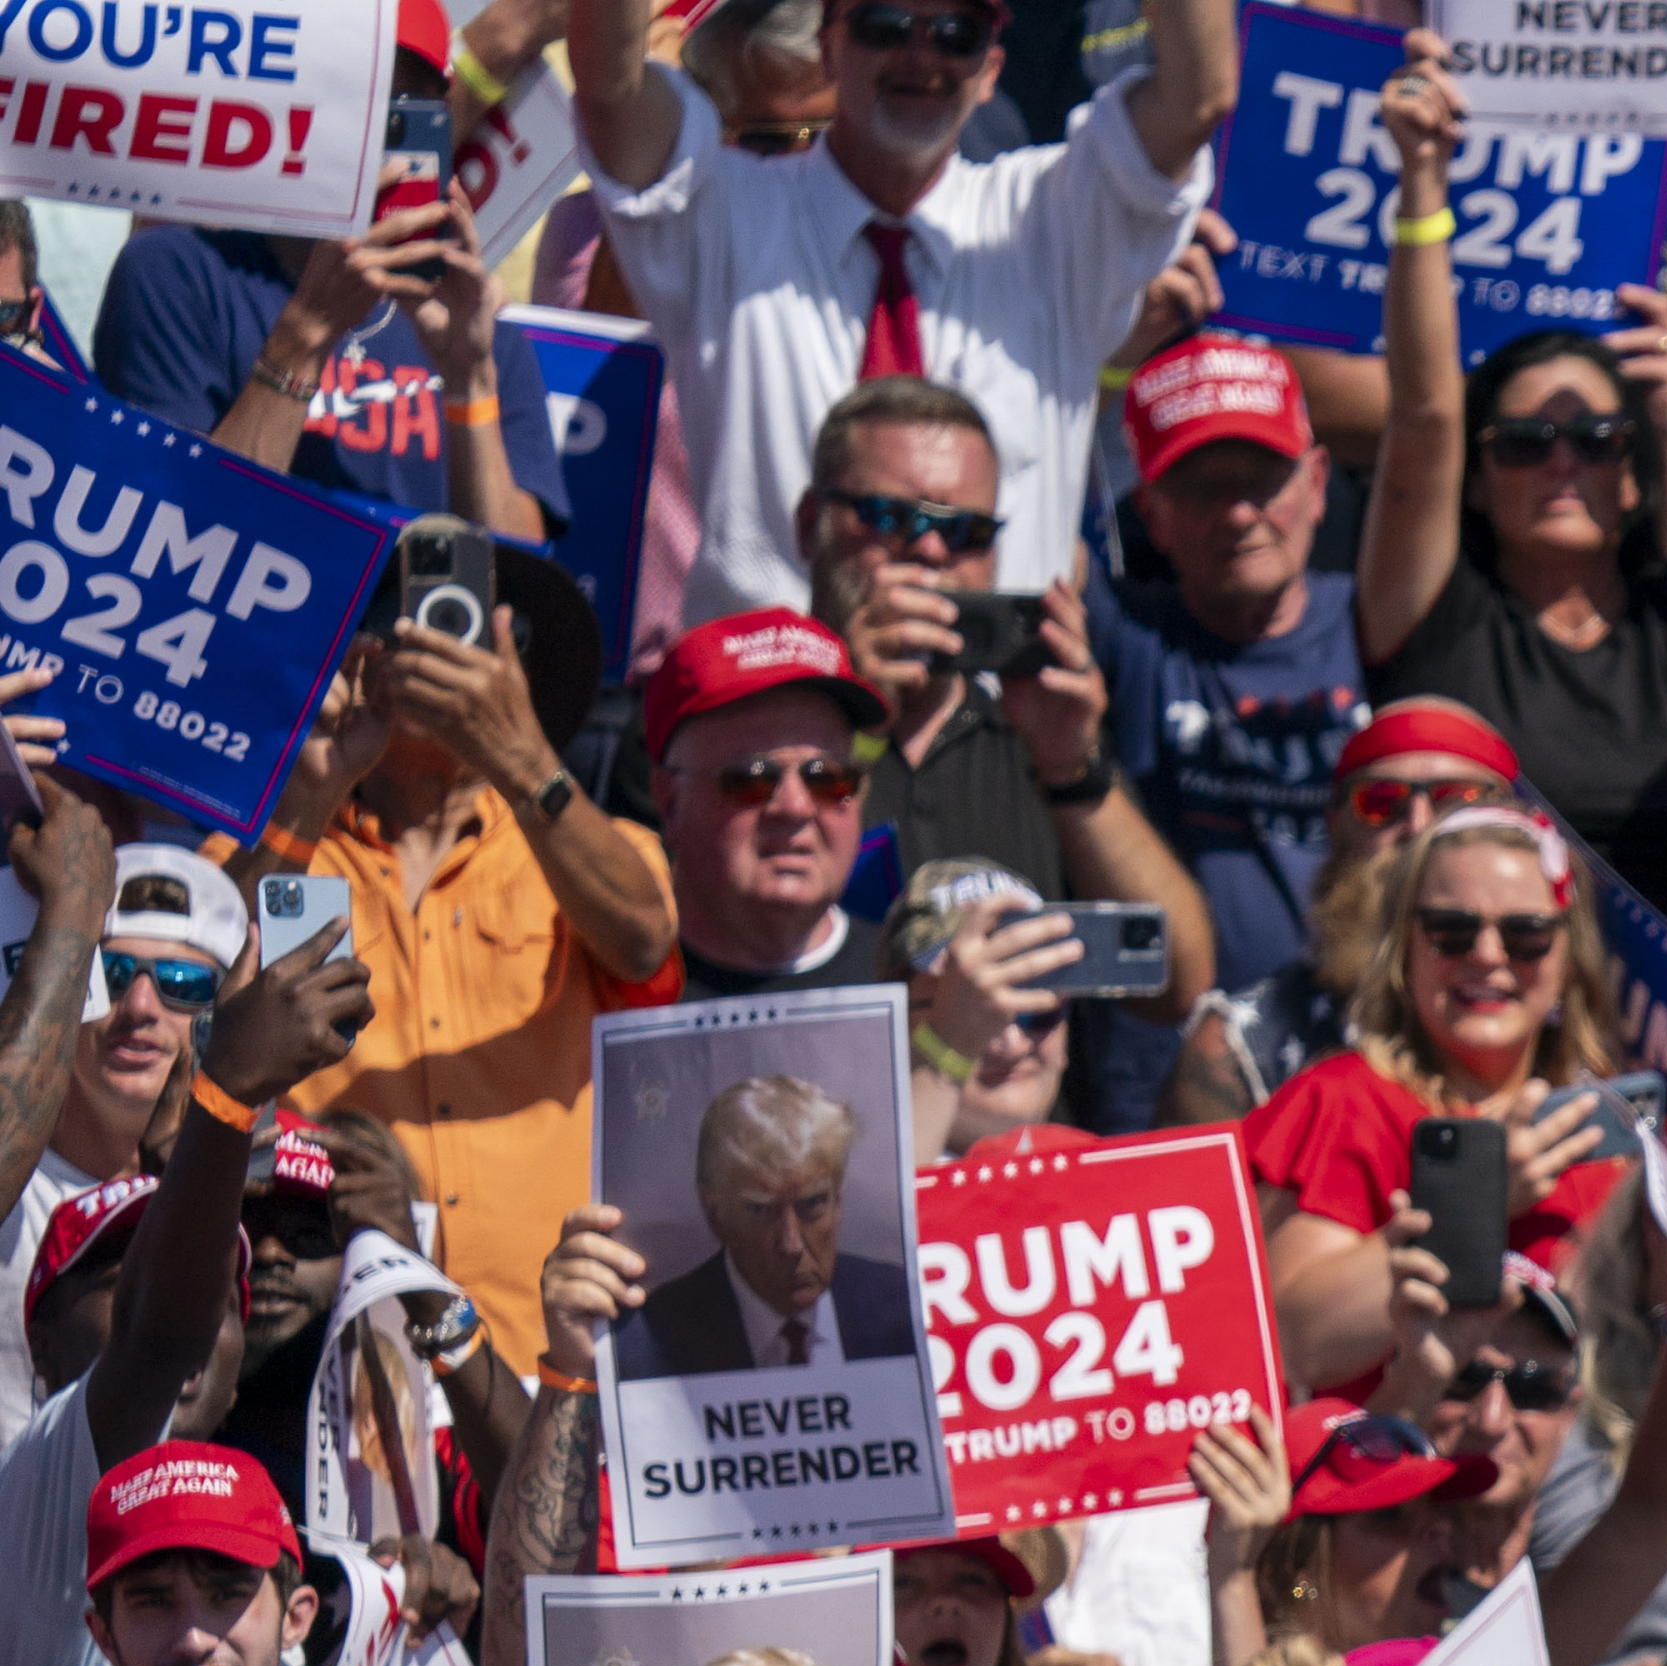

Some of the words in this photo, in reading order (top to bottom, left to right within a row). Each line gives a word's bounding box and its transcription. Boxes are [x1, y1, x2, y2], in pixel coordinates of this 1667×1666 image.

[0, 0, 300, 82] OU'RE
[0, 77, 314, 177] IRED!
[1304, 166, 1584, 276] 224
[1525, 284, 1630, 321] 8802
[0, 424, 313, 622] RUMP
[0, 540, 218, 690] 024
[77, 663, 124, 704] TO
[133, 691, 251, 762] 88022
[917, 1205, 1215, 1330] RUMP
[703, 1394, 852, 1443] NEVER
[943, 1416, 1078, 1465] TRUMP
[1085, 1407, 1135, 1443] TO
[1143, 1387, 1252, 1434] 88022
[117, 1480, 172, 1516] GREAT
[173, 1477, 234, 1498] AGAIN
[155, 1459, 240, 1481] AMERICA
[642, 1439, 921, 1499] SURRENDER
